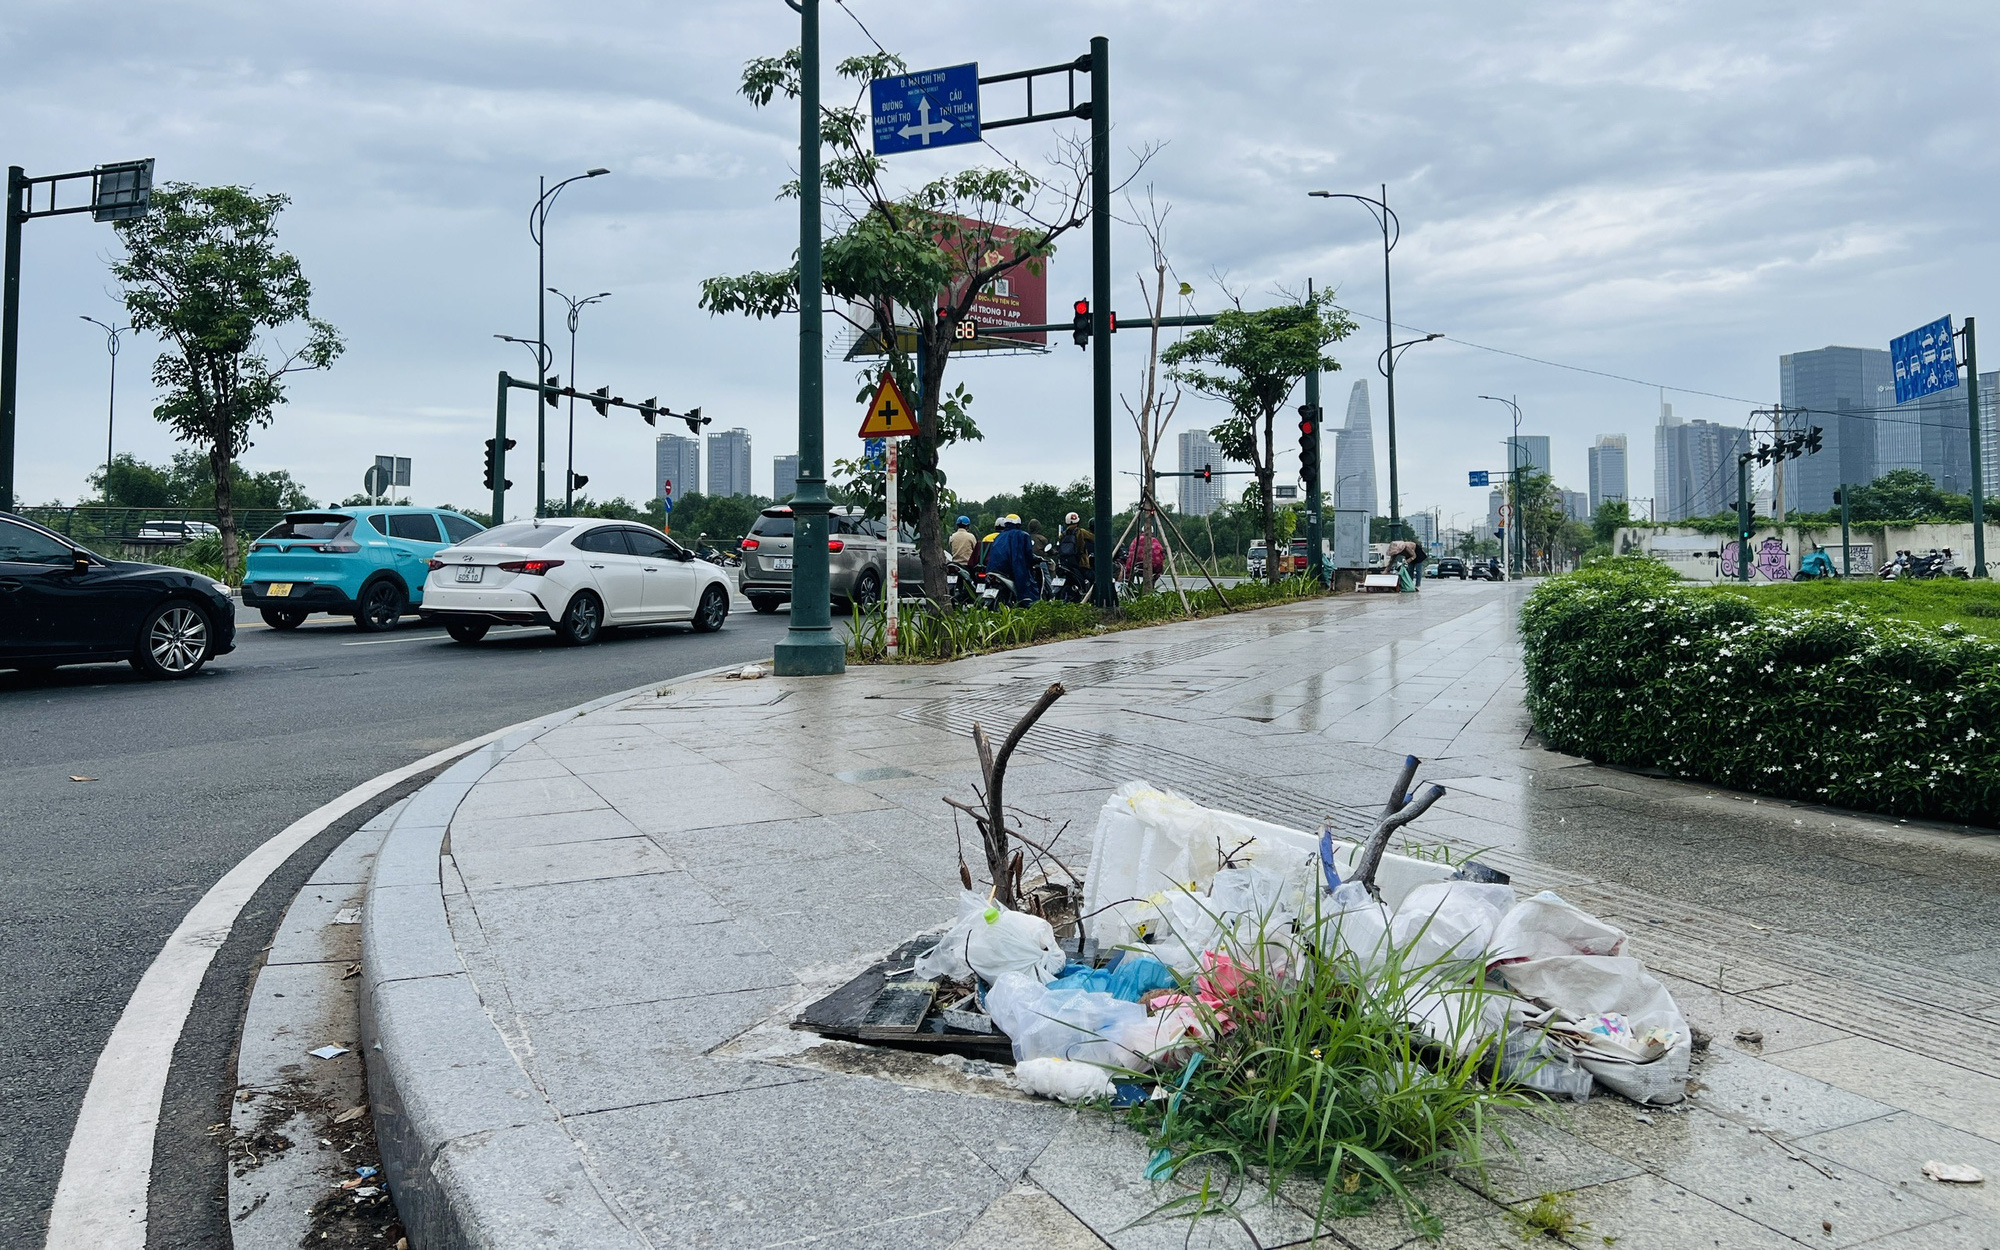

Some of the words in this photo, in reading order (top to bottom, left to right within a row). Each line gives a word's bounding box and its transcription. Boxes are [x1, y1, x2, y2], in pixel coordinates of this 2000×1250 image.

[908, 76, 920, 87] MAI
[921, 73, 932, 84] CHÍ
[933, 72, 946, 83] THỌ
[953, 101, 974, 114] THIÊM
[874, 116, 886, 126] MAI
[886, 112, 898, 124] CHÍ
[899, 112, 911, 123] THỌ
[979, 306, 1001, 316] TRONG
[1008, 310, 1021, 319] APP
